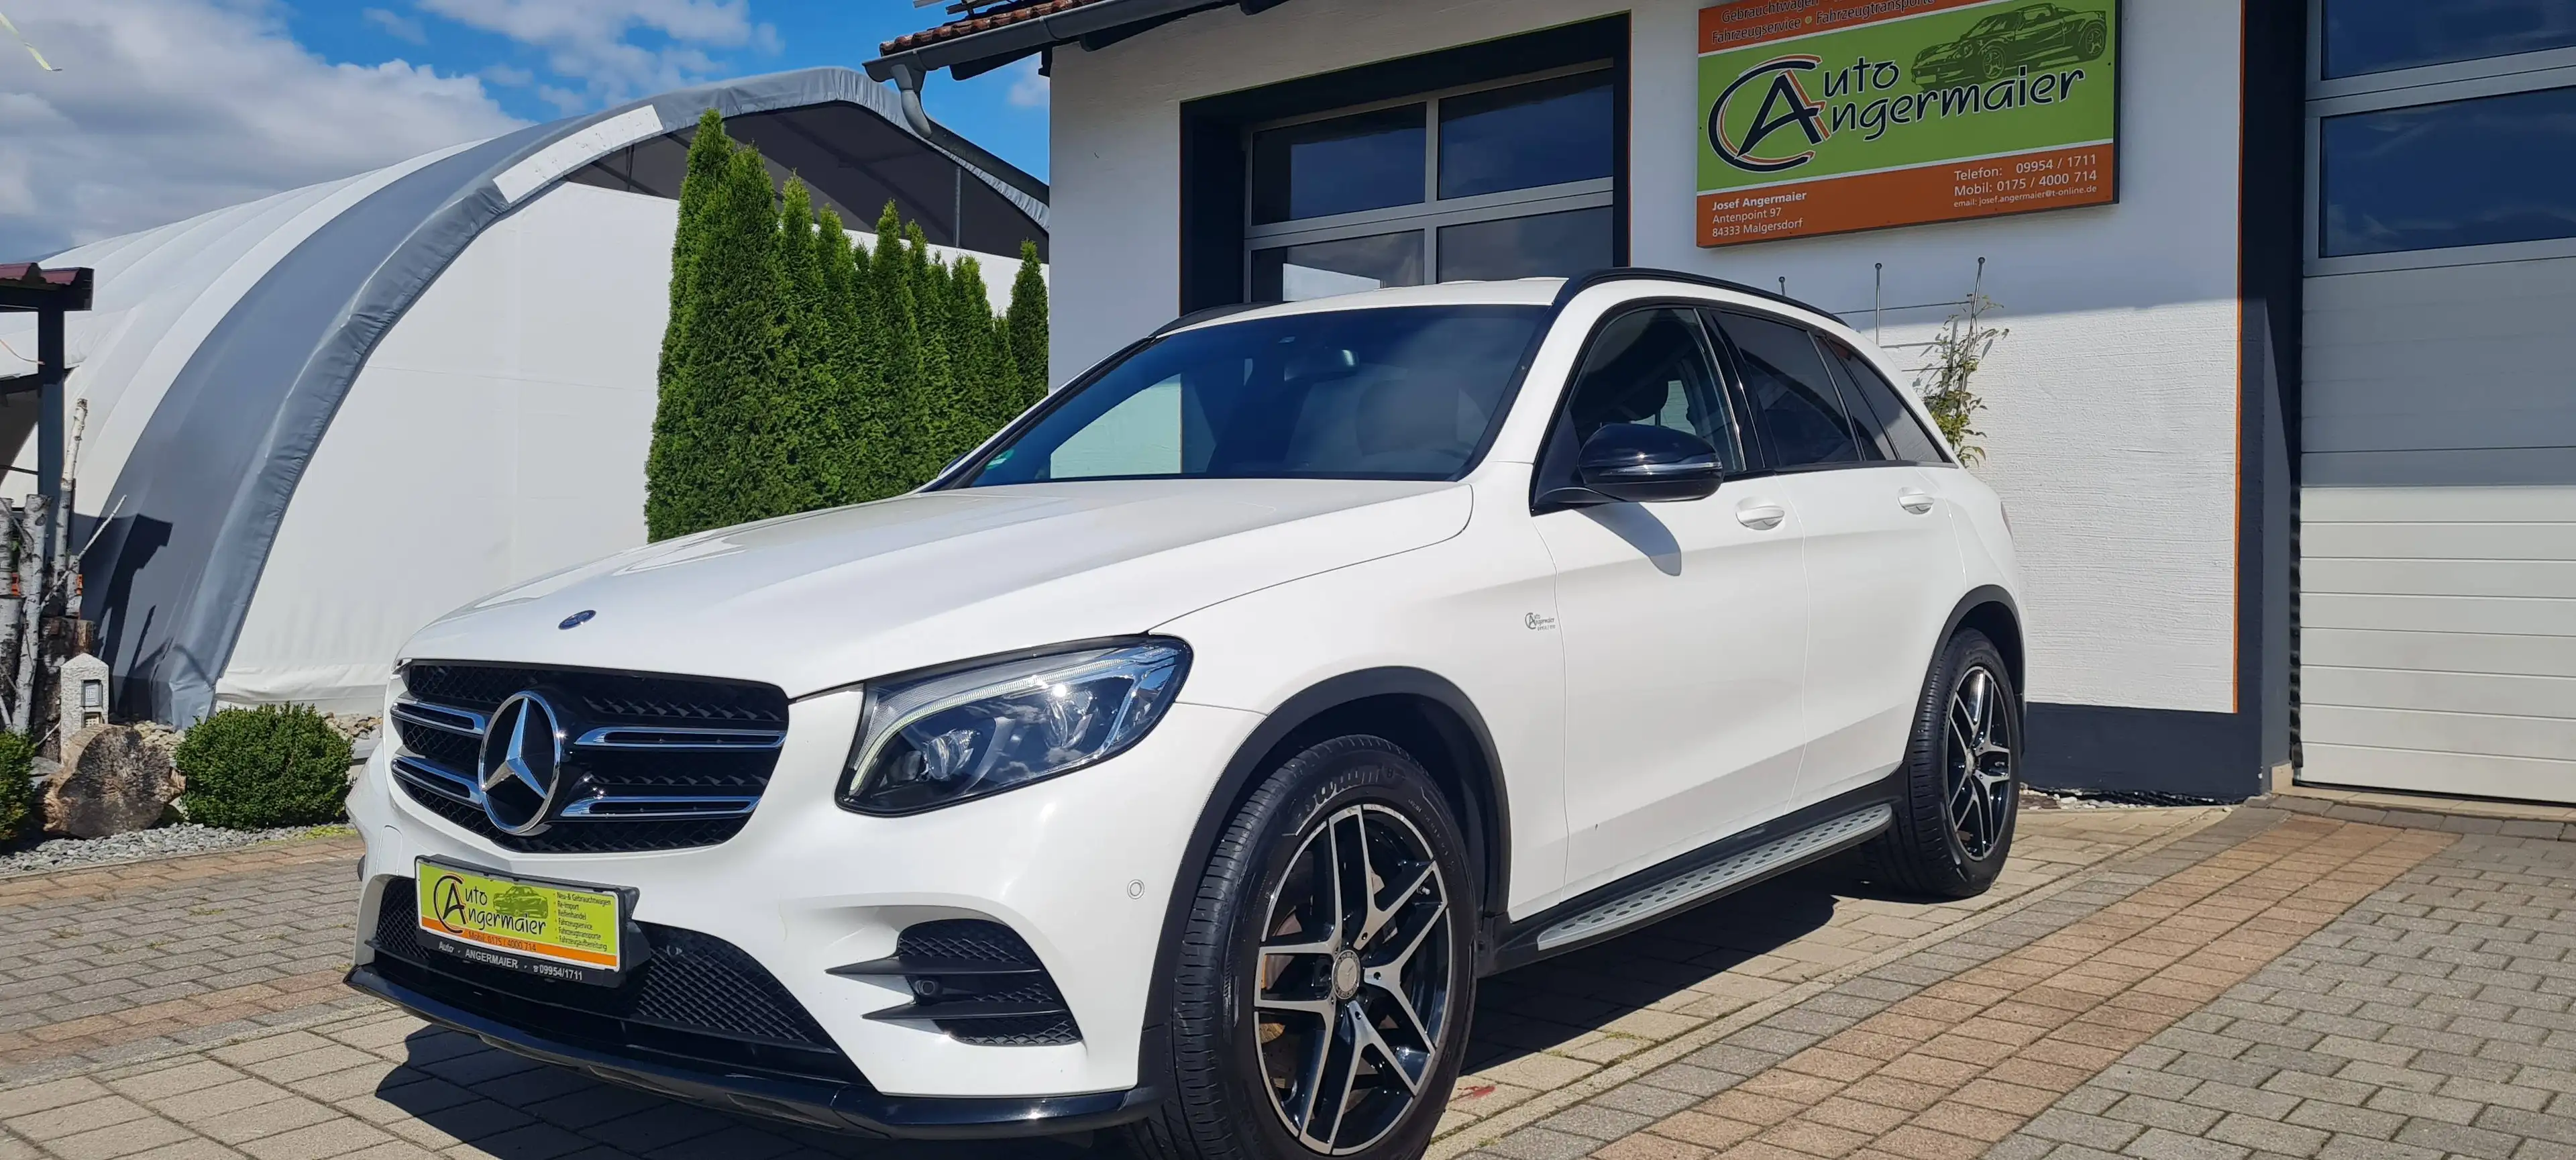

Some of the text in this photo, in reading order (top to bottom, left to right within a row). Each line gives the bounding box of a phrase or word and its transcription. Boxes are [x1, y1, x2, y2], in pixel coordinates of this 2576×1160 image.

[1712, 17, 1801, 44] Fahrzeugservice
[1954, 167, 2002, 180] Telefon:
[2016, 160, 2053, 174] 09954
[2068, 154, 2096, 167] 1711
[1954, 182, 1992, 196] Mobil:
[1997, 178, 2026, 191] 0175
[2039, 173, 2069, 186] 4000
[2074, 170, 2096, 182] 714
[1713, 191, 1807, 211] Josef Angermaier
[1953, 185, 2096, 207] email: josef.angermaier@t-online.de
[1713, 207, 1782, 223] Antenpoint 97
[1713, 217, 1803, 237] 84333 Malgersdorf
[439, 941, 454, 953] Auto
[465, 949, 519, 969] ANGERMAIER
[539, 965, 582, 980] 09954/1711
